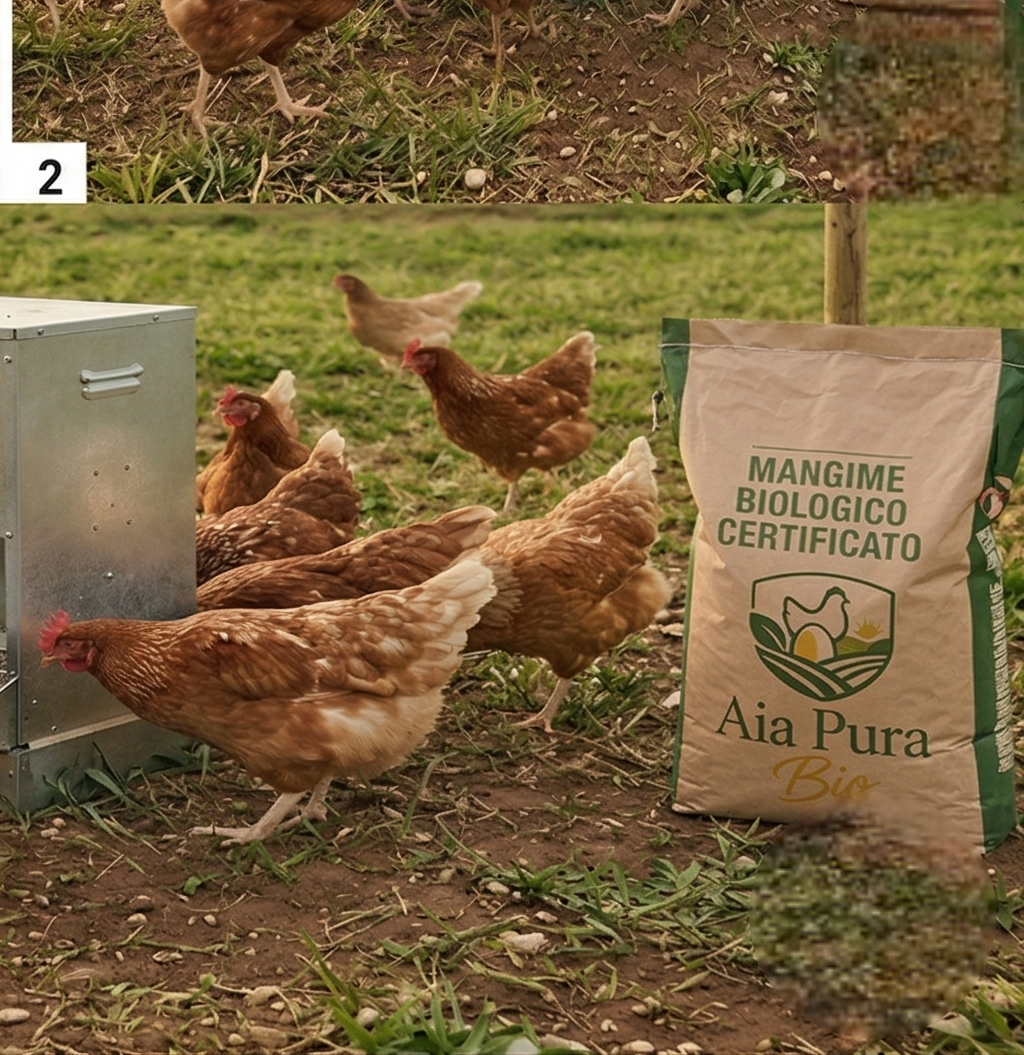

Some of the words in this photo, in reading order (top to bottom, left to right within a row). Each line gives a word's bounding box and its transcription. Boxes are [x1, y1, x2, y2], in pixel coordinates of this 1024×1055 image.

[748, 455, 906, 494] MANGIME
[735, 486, 907, 527] BIOLOGICO
[717, 517, 922, 563] CERTIFICATO
[715, 695, 797, 747] Aia
[811, 708, 933, 759] Pura
